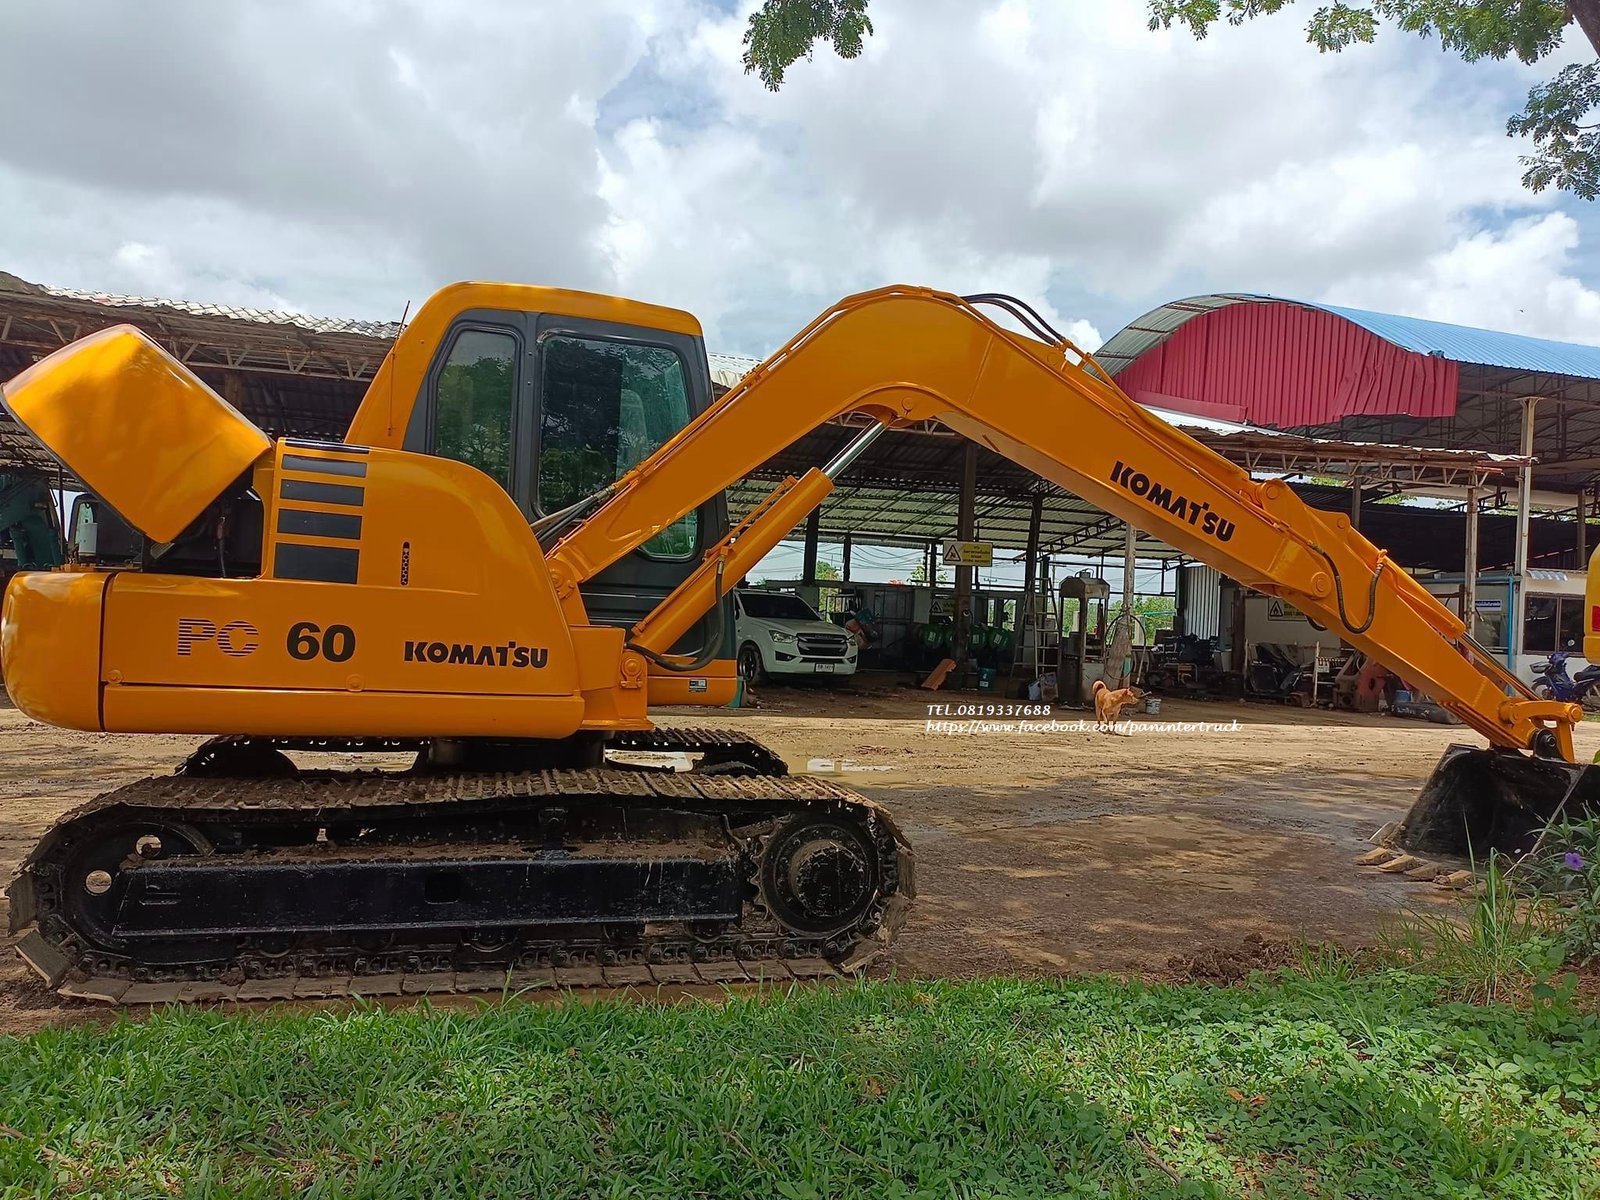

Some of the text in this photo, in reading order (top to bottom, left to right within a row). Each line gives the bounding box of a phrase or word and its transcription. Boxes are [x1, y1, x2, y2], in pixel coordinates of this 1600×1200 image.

[1110, 460, 1236, 542] KOMATSU
[177, 618, 356, 663] PC 60
[404, 640, 548, 668] KOMATSU
